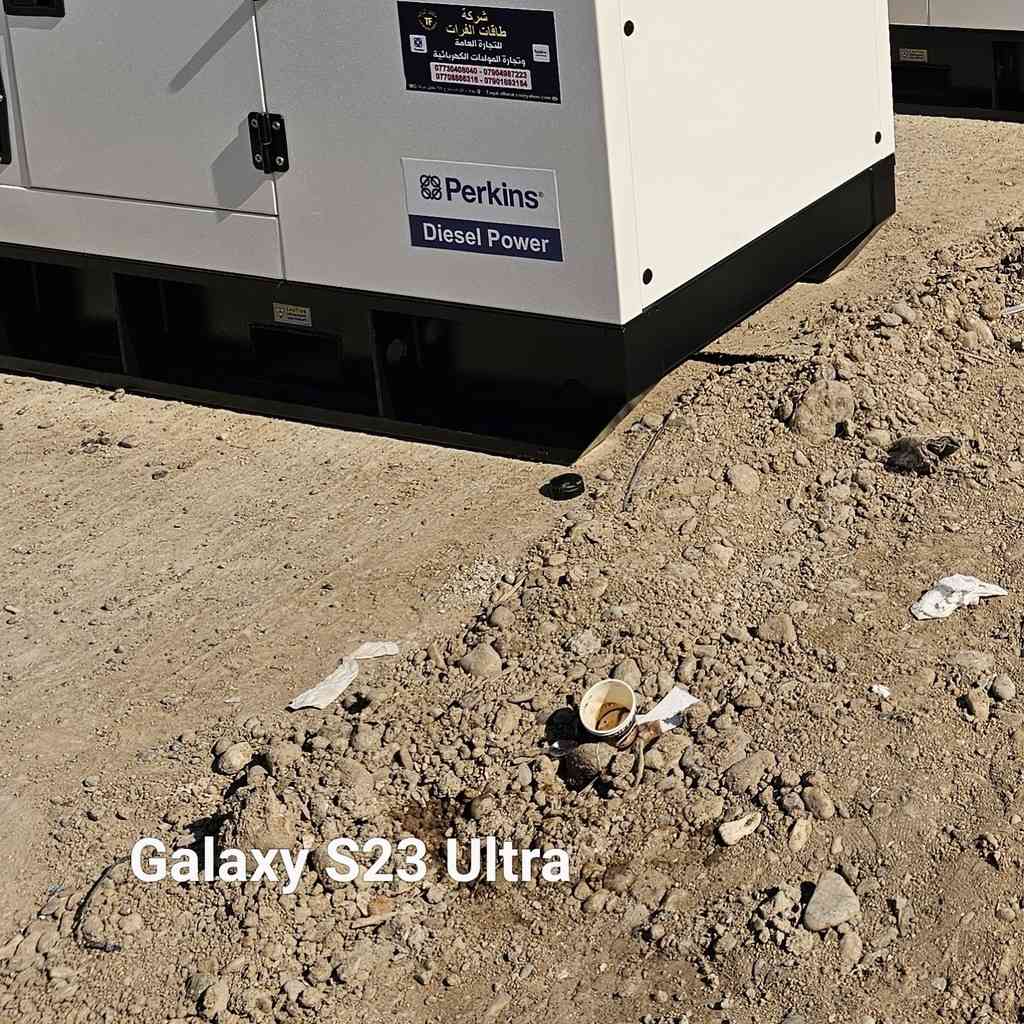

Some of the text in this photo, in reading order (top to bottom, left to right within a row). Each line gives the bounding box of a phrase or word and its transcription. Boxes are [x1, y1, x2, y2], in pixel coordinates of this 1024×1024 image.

[461, 8, 488, 23] شركة
[479, 25, 507, 37] طاقات
[422, 222, 549, 253] Diesel Power
